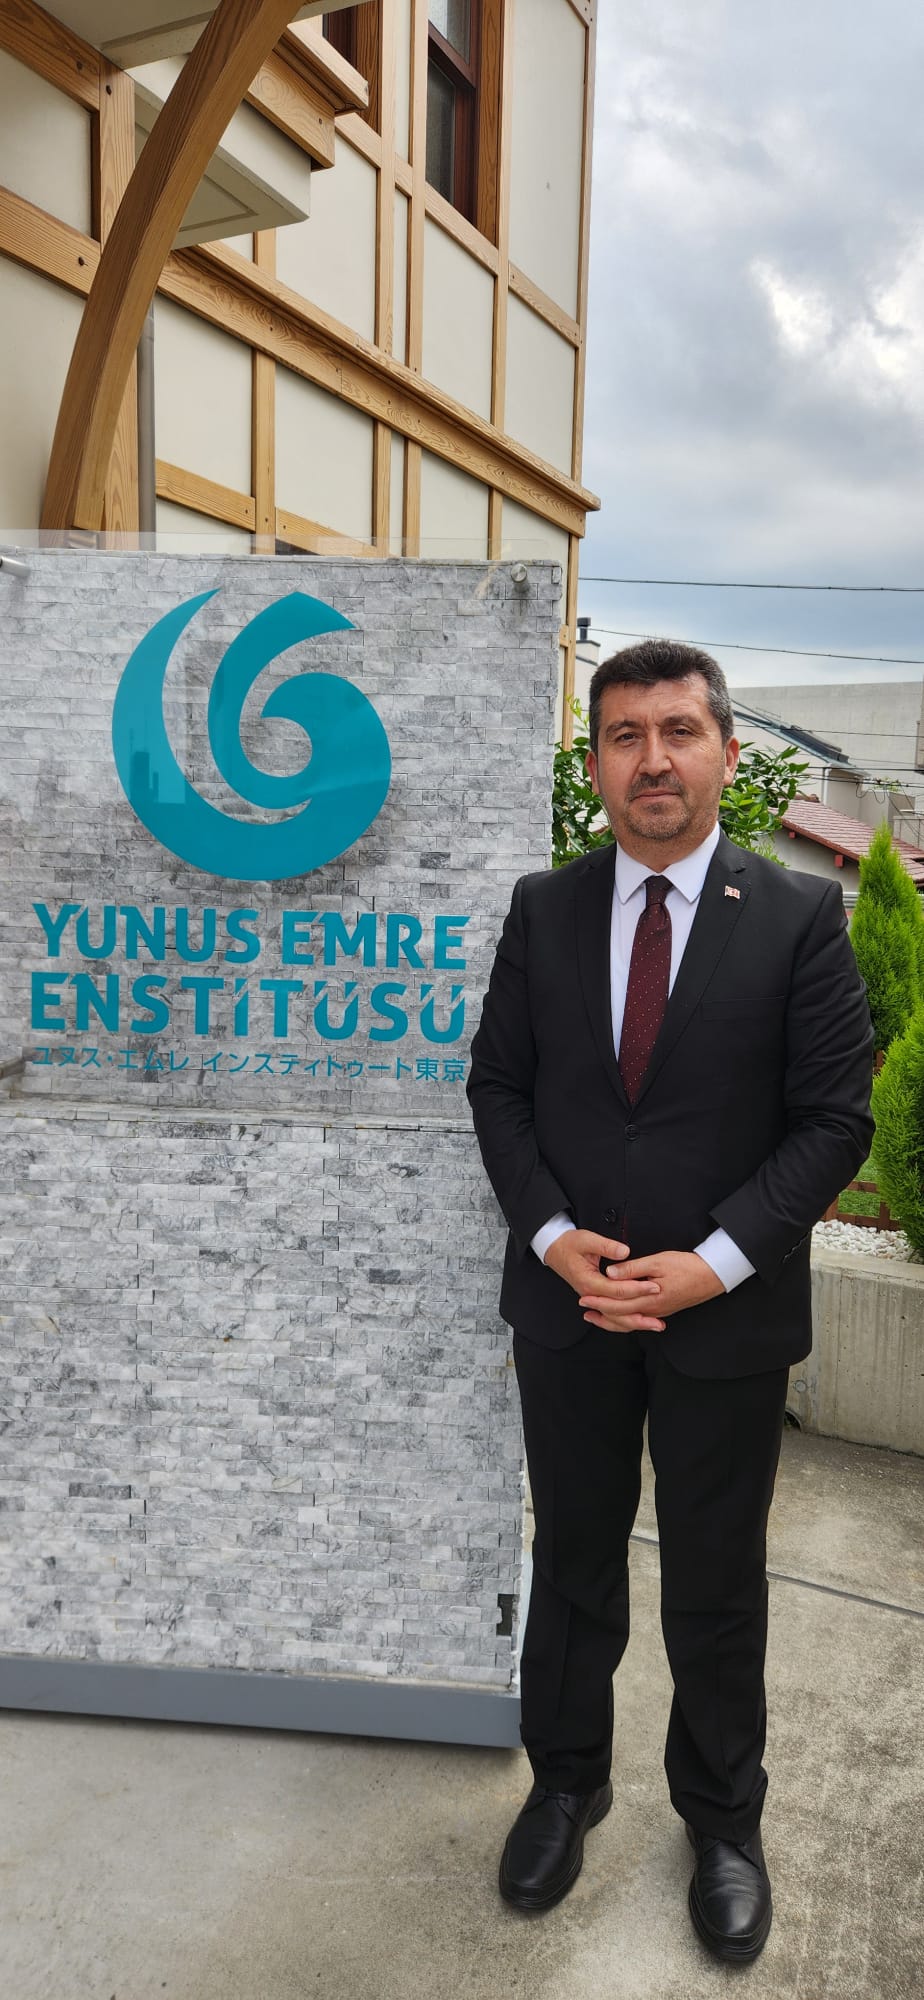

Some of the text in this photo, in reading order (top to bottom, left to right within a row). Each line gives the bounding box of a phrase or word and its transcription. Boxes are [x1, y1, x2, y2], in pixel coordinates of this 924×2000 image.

[31, 902, 471, 971] YUNUS EMRE
[30, 971, 466, 1045] ENSTİTÜSÜ
[32, 1046, 467, 1083] ユヌス・エムレ インスティトゥート東京
